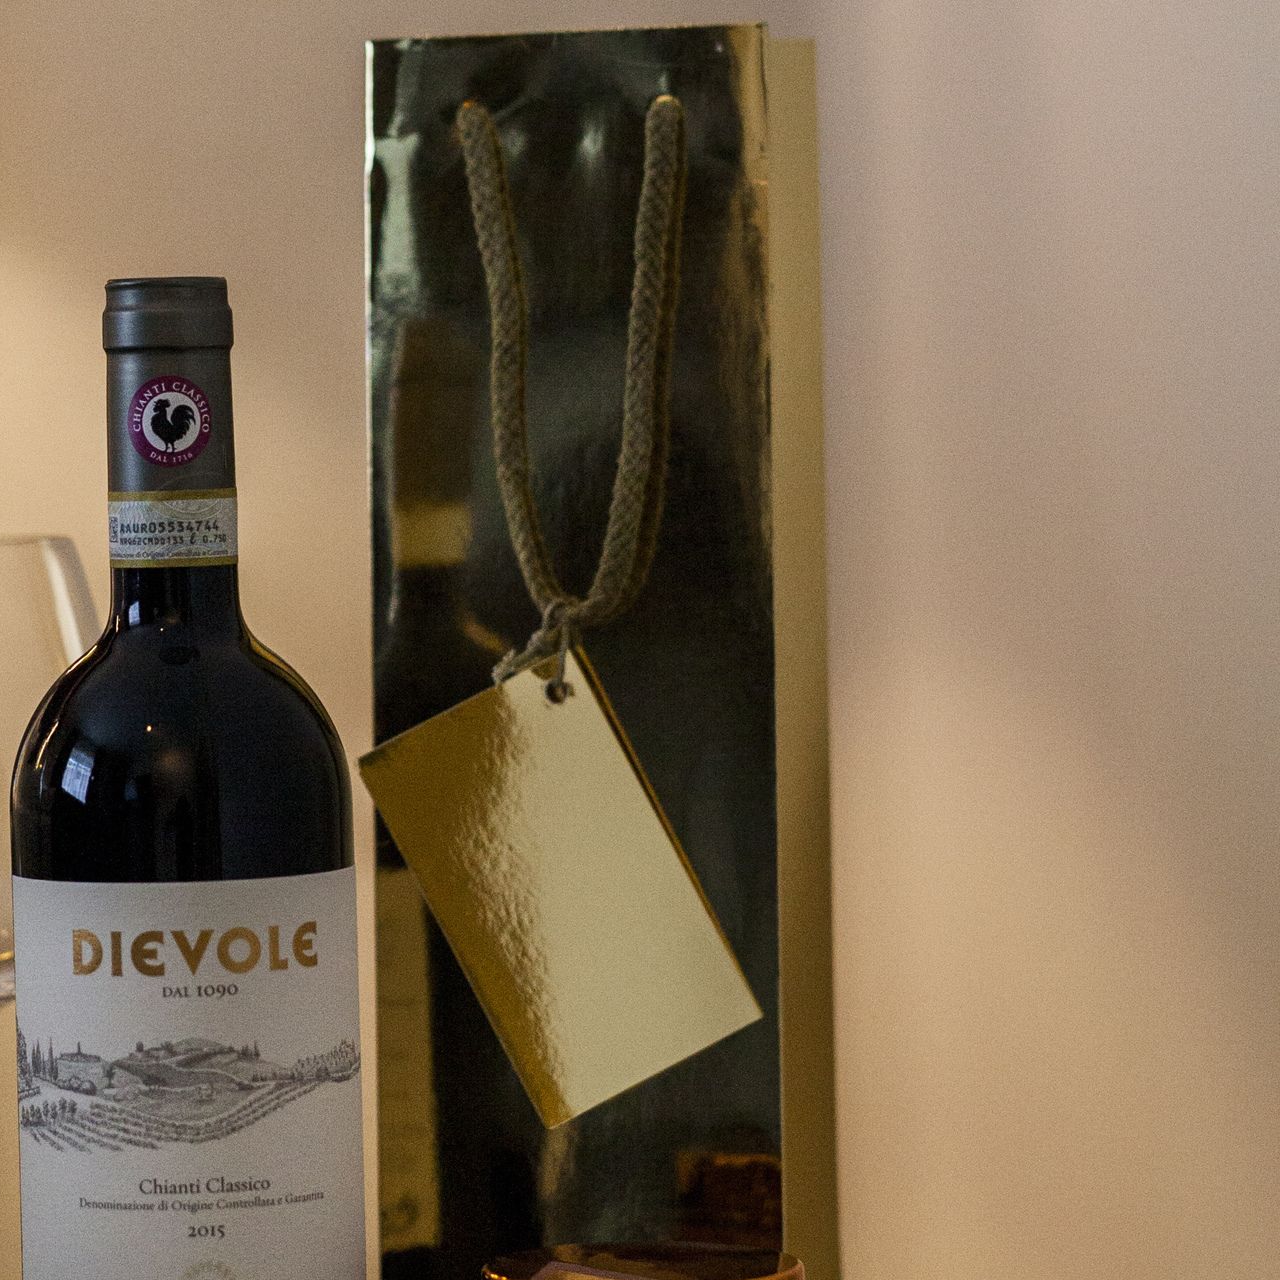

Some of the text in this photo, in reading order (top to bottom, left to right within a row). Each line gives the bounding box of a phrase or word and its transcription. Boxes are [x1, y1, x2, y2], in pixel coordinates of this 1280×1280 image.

[133, 382, 210, 433] CHIANTI CLASSICO
[149, 451, 193, 463] DAL 1716
[72, 920, 319, 977] DIEVOLE
[162, 983, 240, 998] DAL 1090
[139, 1176, 272, 1195] Chianti Classico
[79, 1197, 155, 1211] Denominazione
[157, 1200, 168, 1211] di
[171, 1199, 214, 1214] Origine
[216, 1196, 275, 1210] Controllata
[277, 1196, 283, 1205] e
[188, 1224, 226, 1239] 2015
